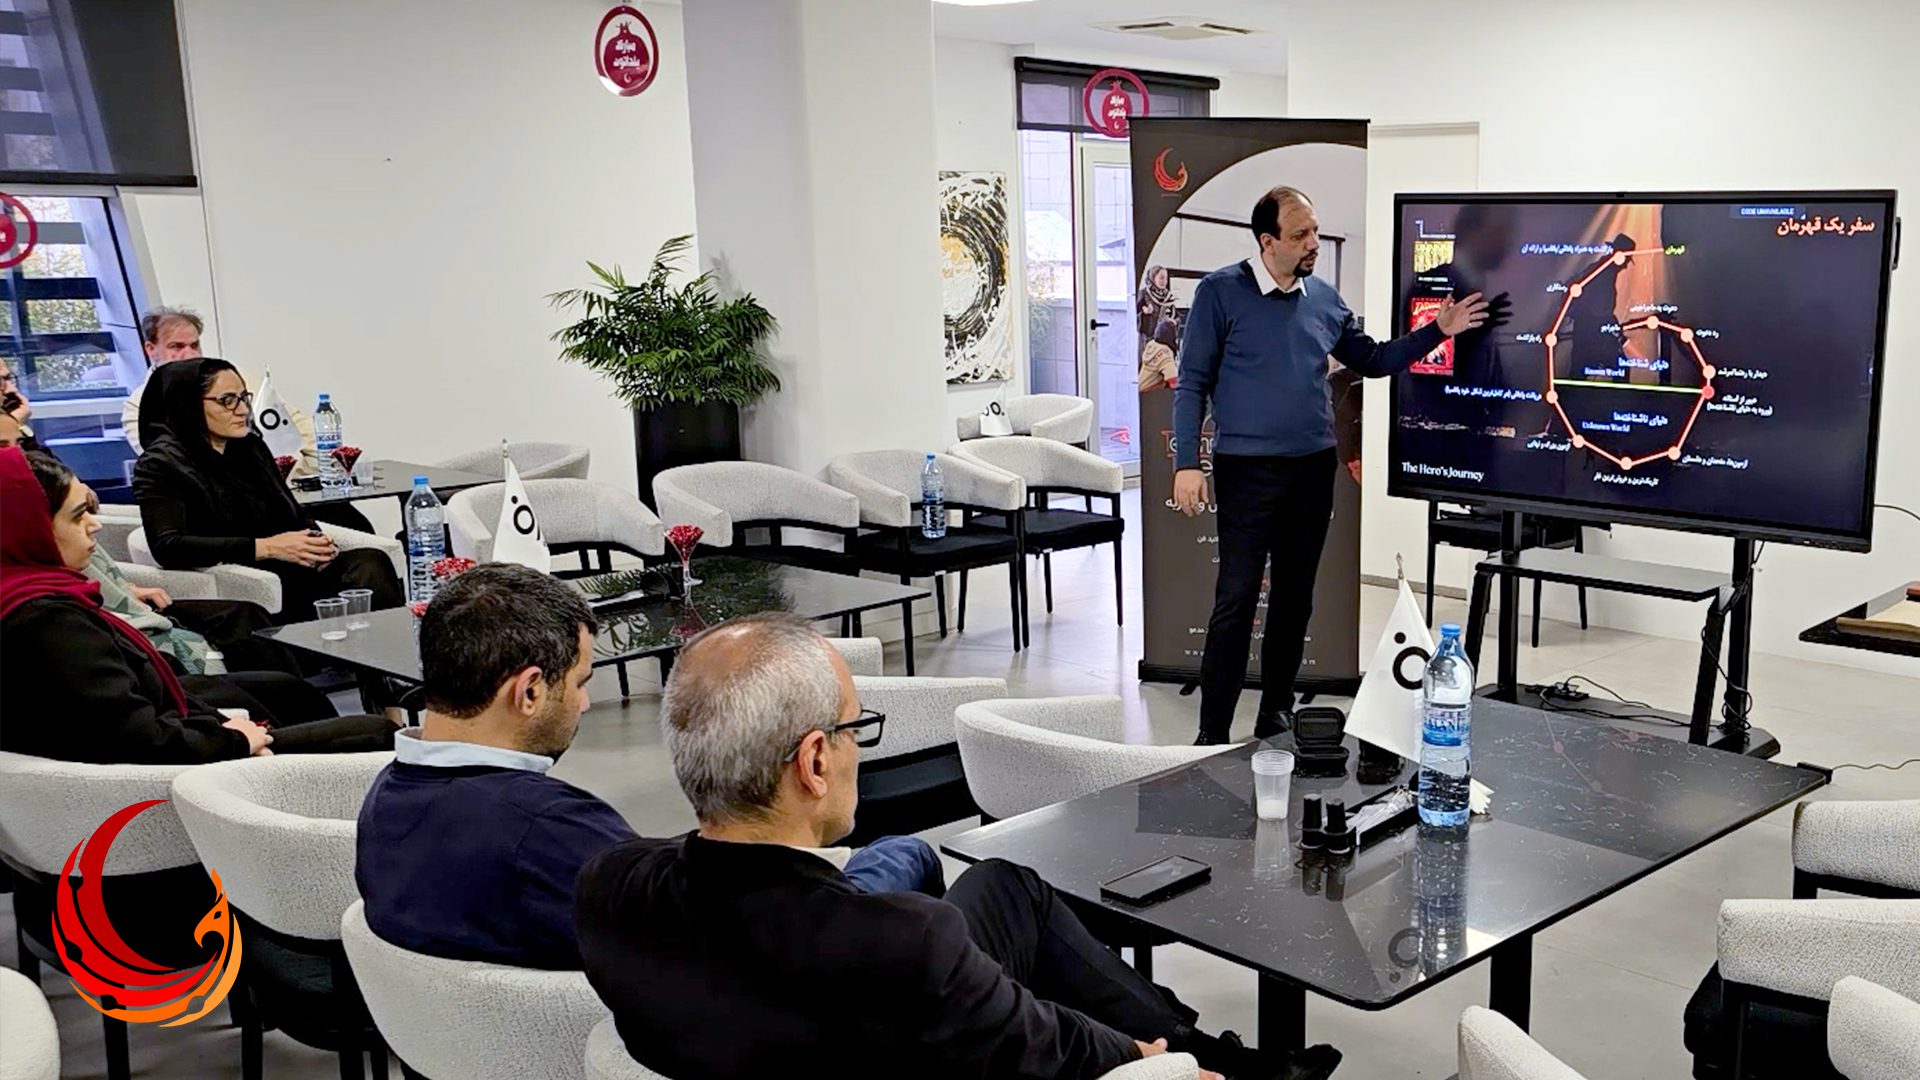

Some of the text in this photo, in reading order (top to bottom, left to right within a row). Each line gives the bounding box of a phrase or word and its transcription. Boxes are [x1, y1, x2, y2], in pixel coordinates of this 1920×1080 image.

[1741, 207, 1756, 216] CODE
[1776, 216, 1875, 236] سفر یک قهرمان
[1665, 245, 1685, 255] قهرمان
[1401, 461, 1485, 483] The Hero's Journey
